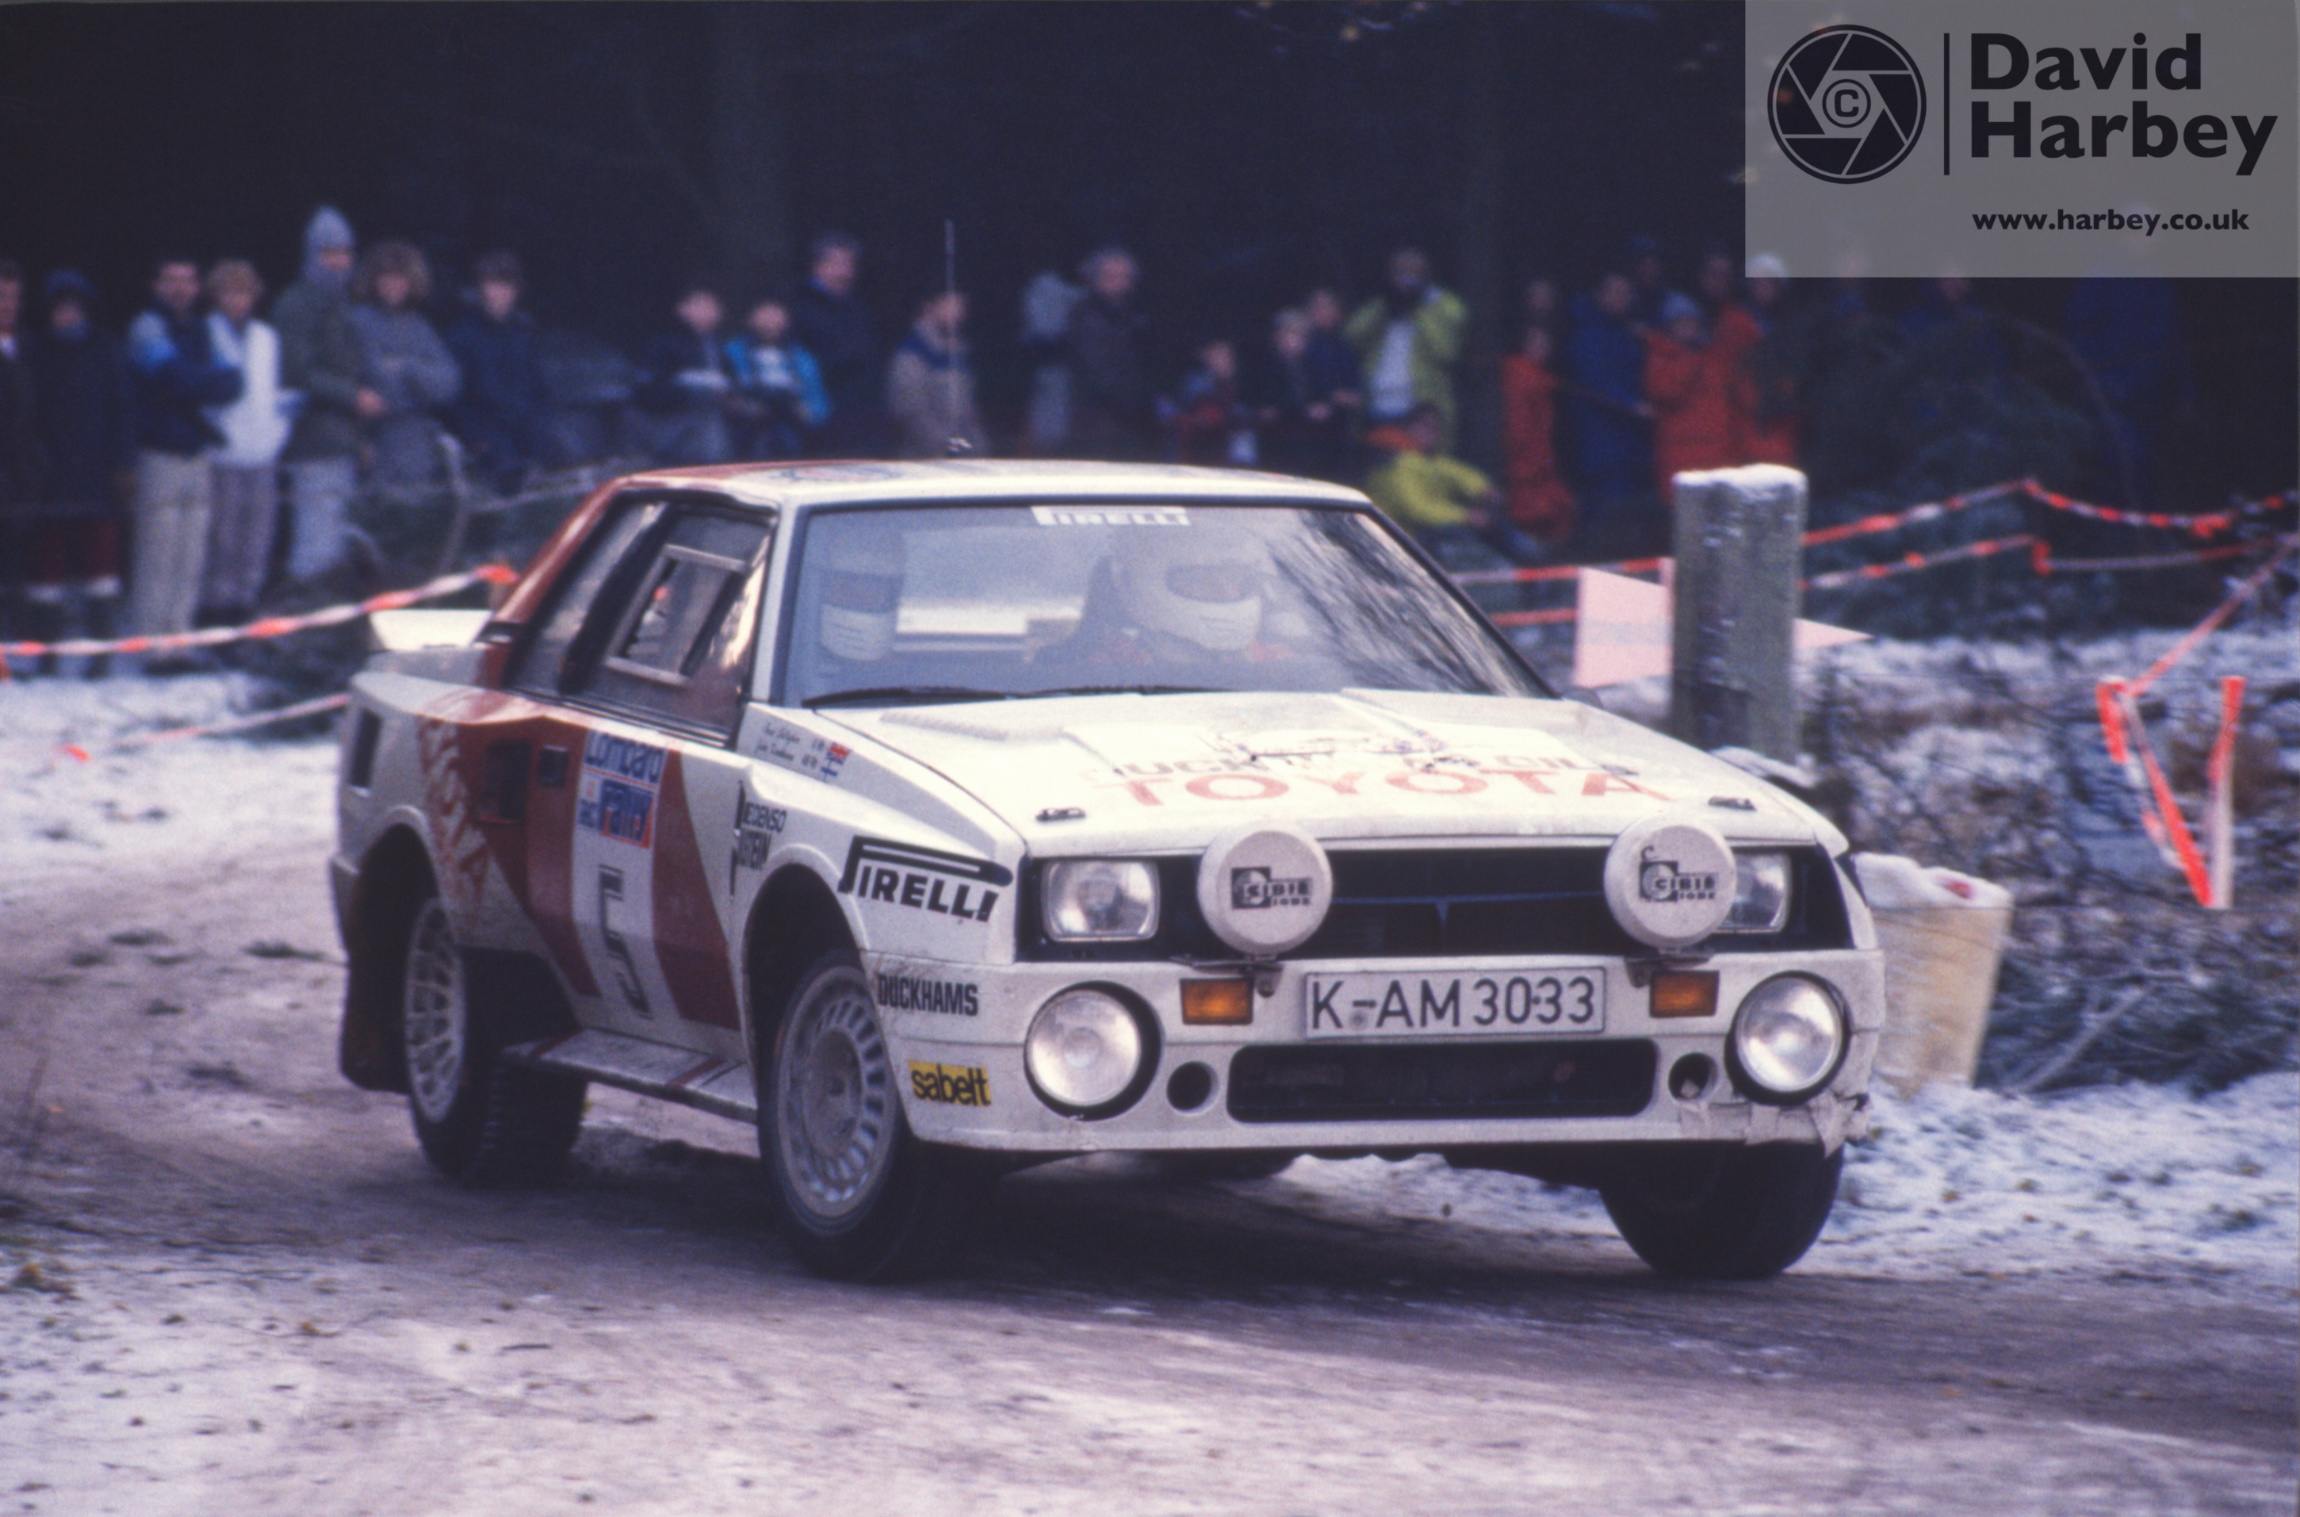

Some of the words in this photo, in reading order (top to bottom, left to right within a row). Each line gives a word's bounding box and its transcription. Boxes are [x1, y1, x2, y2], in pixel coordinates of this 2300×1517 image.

[1090, 767, 1678, 807] TOYOTA
[837, 835, 1014, 923] PIRELLI
[598, 863, 654, 1020] 5
[876, 974, 979, 1017] DUCKHAMS
[910, 1063, 991, 1107] sabelt
